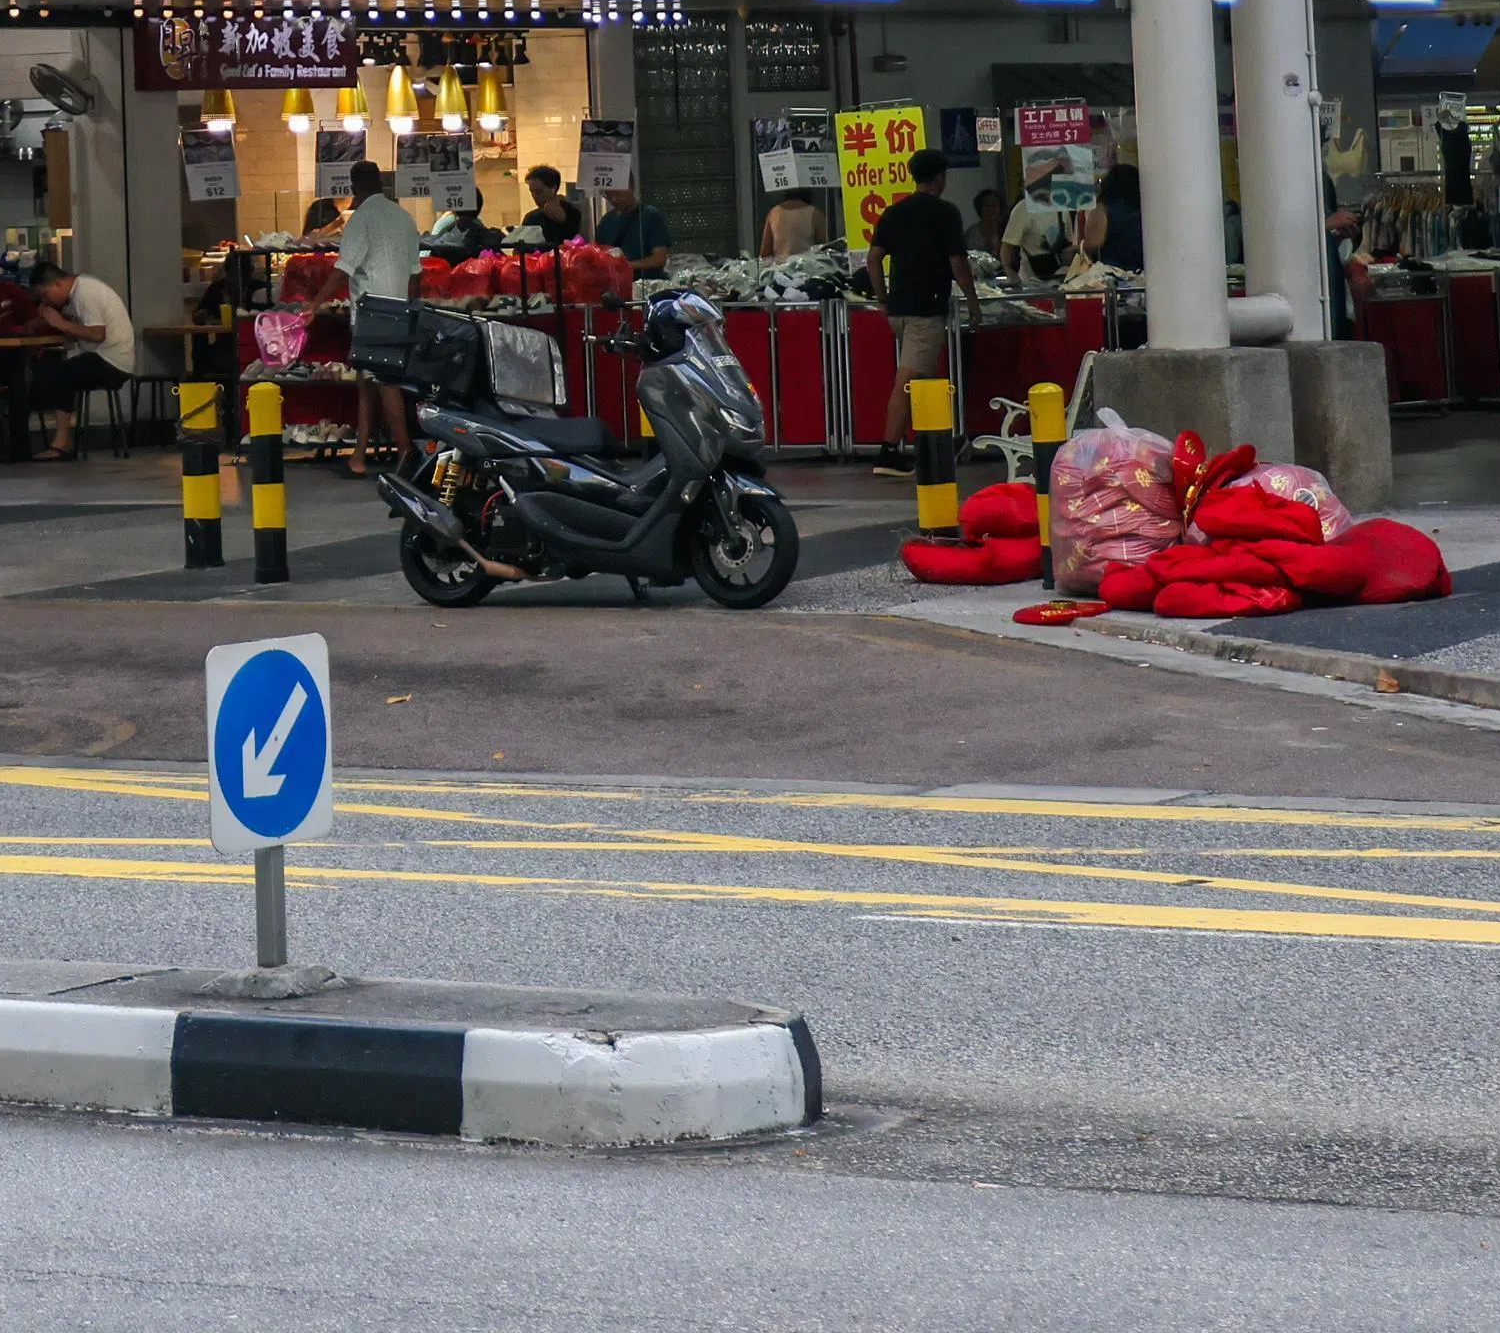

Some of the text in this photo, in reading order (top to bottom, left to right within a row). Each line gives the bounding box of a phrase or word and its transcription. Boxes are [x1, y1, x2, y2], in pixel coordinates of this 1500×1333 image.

[218, 20, 347, 62] 新加坡美食
[264, 64, 294, 80] Family
[296, 63, 347, 78] Restaurant
[1024, 108, 1084, 123] 工厂直销
[976, 119, 998, 131] OFFER
[843, 119, 918, 157] 半价
[1064, 129, 1079, 141] $1
[846, 160, 914, 187] offer 50
[593, 176, 613, 187] $12
[774, 176, 788, 188] $16
[809, 175, 828, 186] $16
[206, 186, 225, 197] $12
[330, 186, 350, 196] $16
[446, 197, 463, 209] $16
